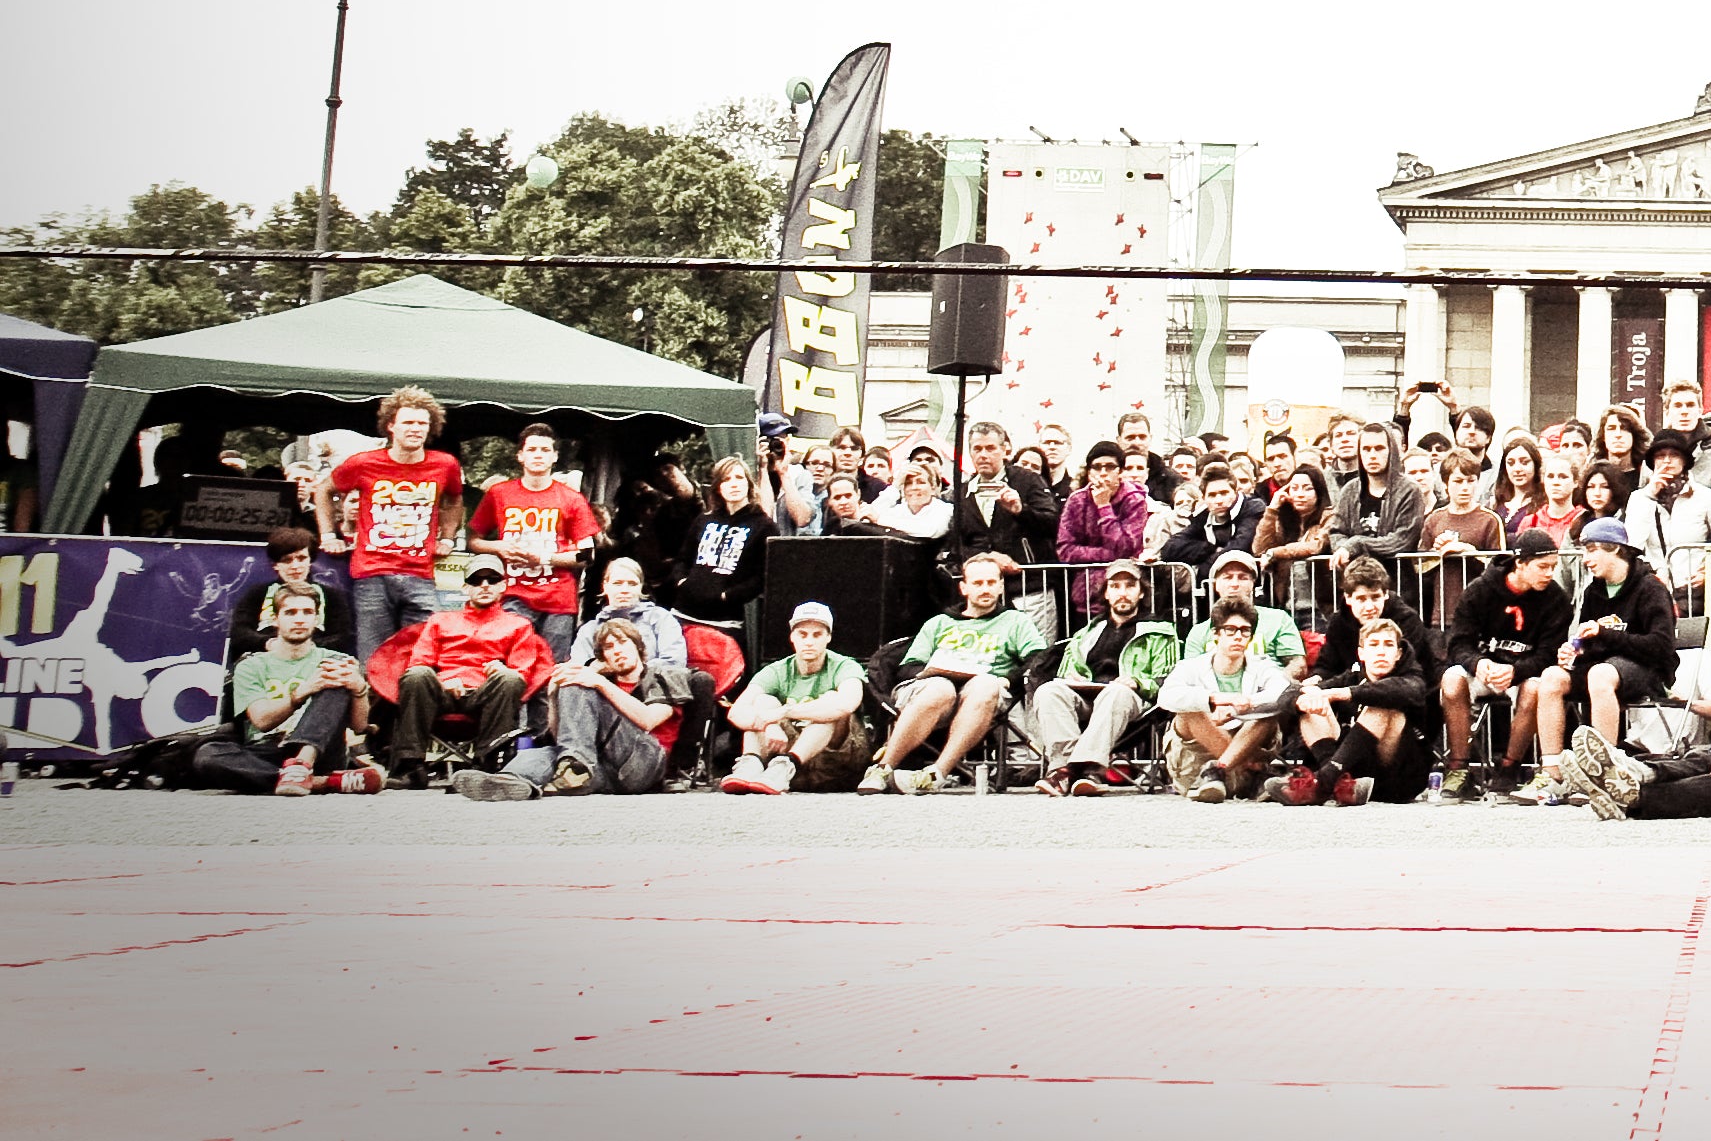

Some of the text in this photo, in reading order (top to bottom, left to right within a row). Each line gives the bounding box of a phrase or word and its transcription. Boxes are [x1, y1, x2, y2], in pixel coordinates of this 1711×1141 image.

[1069, 169, 1103, 184] DAV
[1626, 331, 1652, 392] Troja
[371, 479, 437, 505] 2011
[504, 507, 559, 533] 2011
[0, 657, 85, 694] INE
